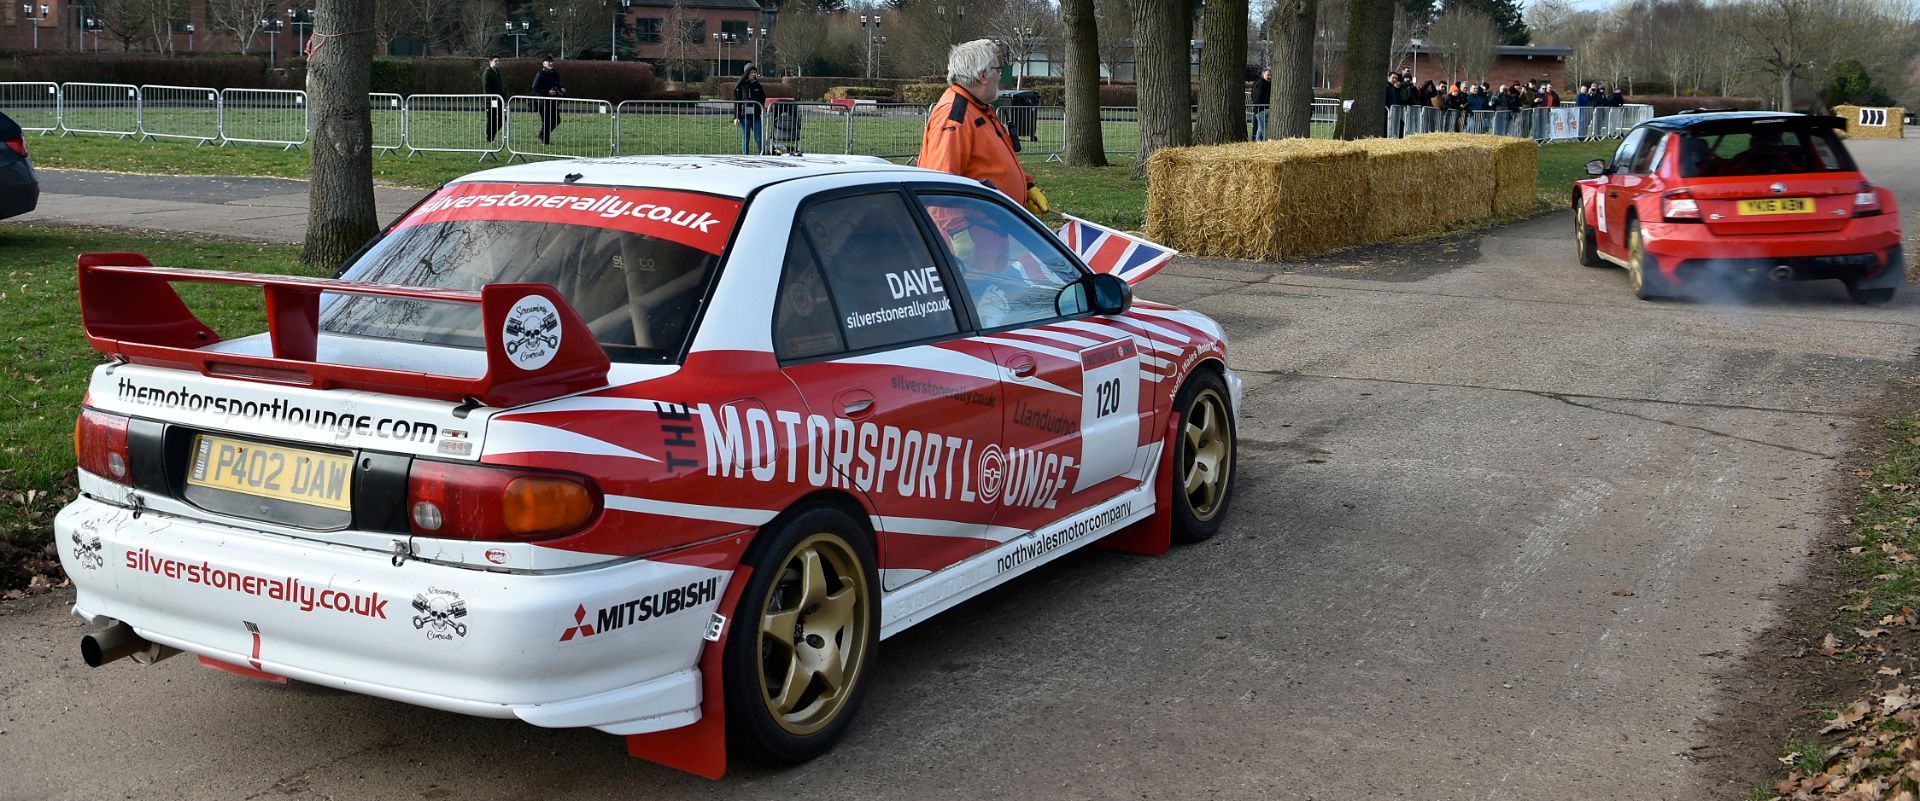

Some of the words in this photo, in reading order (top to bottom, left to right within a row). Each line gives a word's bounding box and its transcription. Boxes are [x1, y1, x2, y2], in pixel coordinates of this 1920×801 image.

[415, 190, 720, 233] silverstonerally.co.uk
[885, 266, 944, 299] DAVE
[846, 295, 952, 329] silverstonerally.co.uk
[117, 376, 438, 444] themotorsportlounge.com
[890, 374, 997, 407] silverstonerally.co.uk
[1096, 377, 1120, 419] 120
[657, 401, 699, 474] THE
[1012, 400, 1076, 436] Llandudno
[214, 443, 285, 490] P402
[290, 454, 348, 502] DAW
[997, 501, 1132, 573] northwalesmotorcompany
[125, 547, 389, 620] silverstonerally.co.uk
[596, 577, 717, 635] MITSUBISHI
